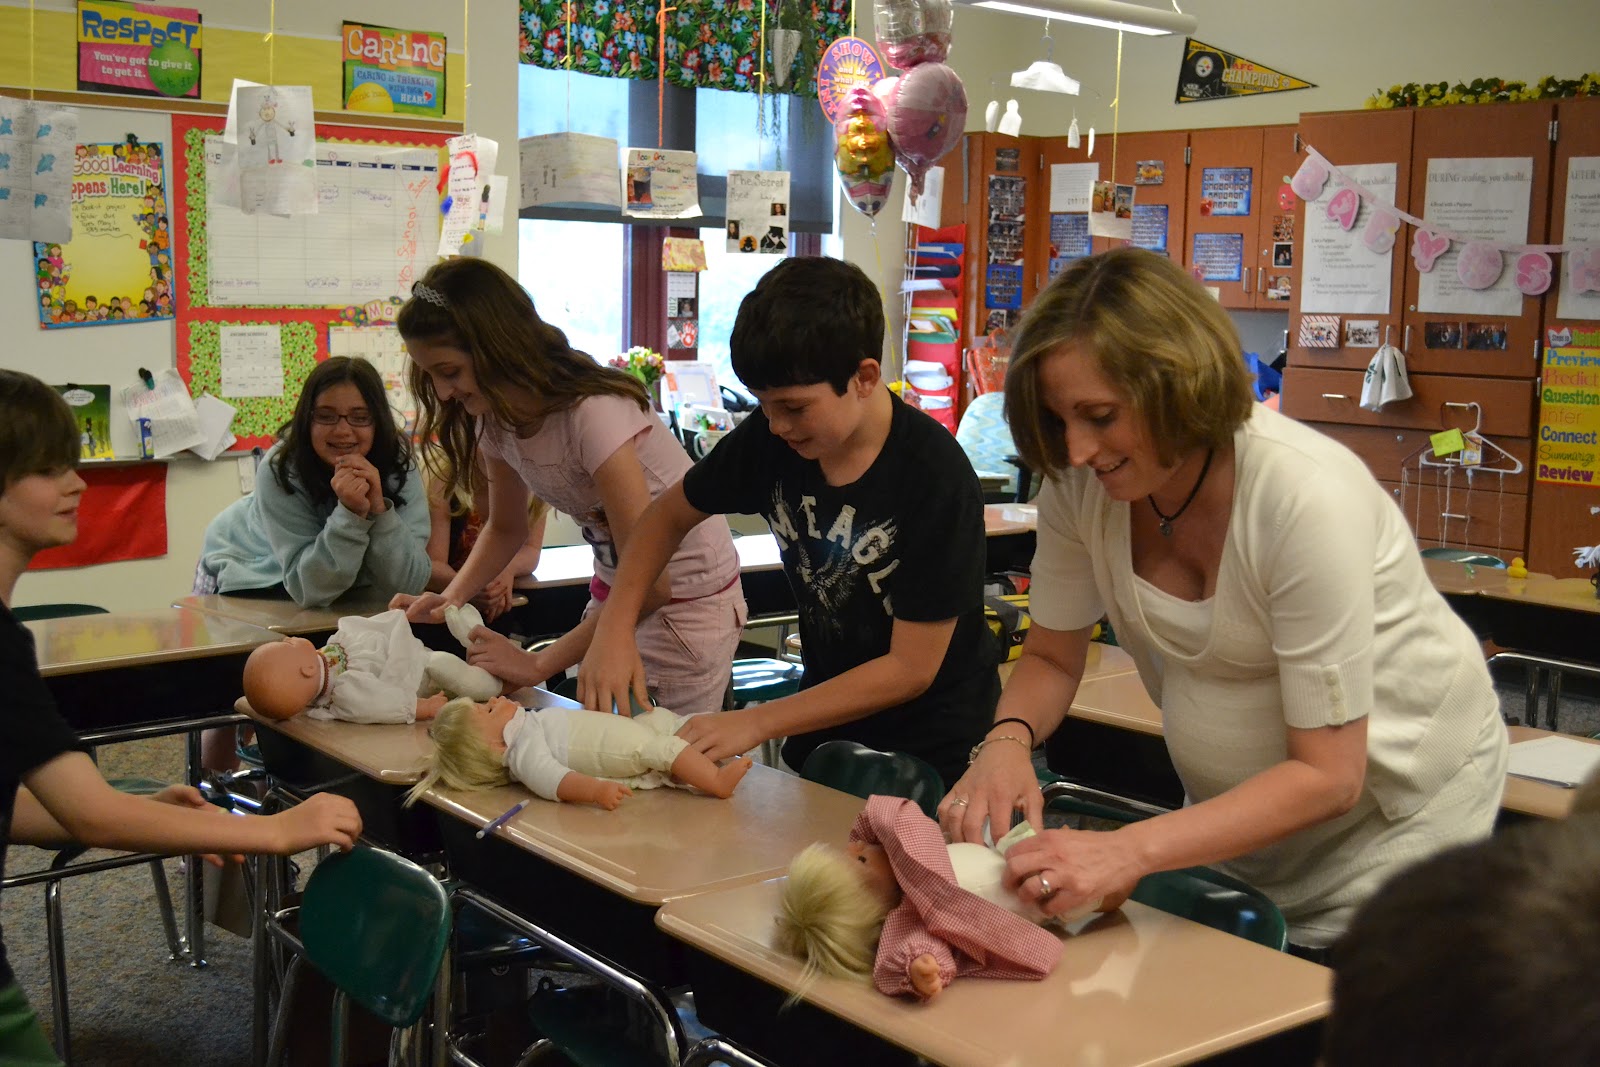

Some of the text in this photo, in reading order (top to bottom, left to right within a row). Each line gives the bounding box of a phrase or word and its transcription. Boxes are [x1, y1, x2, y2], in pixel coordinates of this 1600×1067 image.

[94, 51, 192, 70] You've got to give it
[832, 42, 875, 66] SHOW
[101, 65, 112, 74] to
[839, 66, 866, 76] and do
[1232, 63, 1254, 71] AFC
[1222, 68, 1280, 88] CHAMPIONS
[111, 157, 159, 184] Learning
[1428, 172, 1460, 183] DURING
[1489, 174, 1500, 184] you
[1571, 169, 1597, 180] AFTER
[72, 177, 144, 200] ppens Here!
[729, 173, 784, 187] The Secret
[369, 302, 393, 319] Ma
[668, 296, 677, 316] 2012
[1551, 334, 1564, 342] Steps
[1544, 369, 1598, 388] Predict
[1543, 388, 1600, 405] Question
[1542, 407, 1582, 425] Infer
[1541, 425, 1597, 445] Connect
[1539, 444, 1596, 467] Summarize
[1539, 464, 1594, 482] Review
